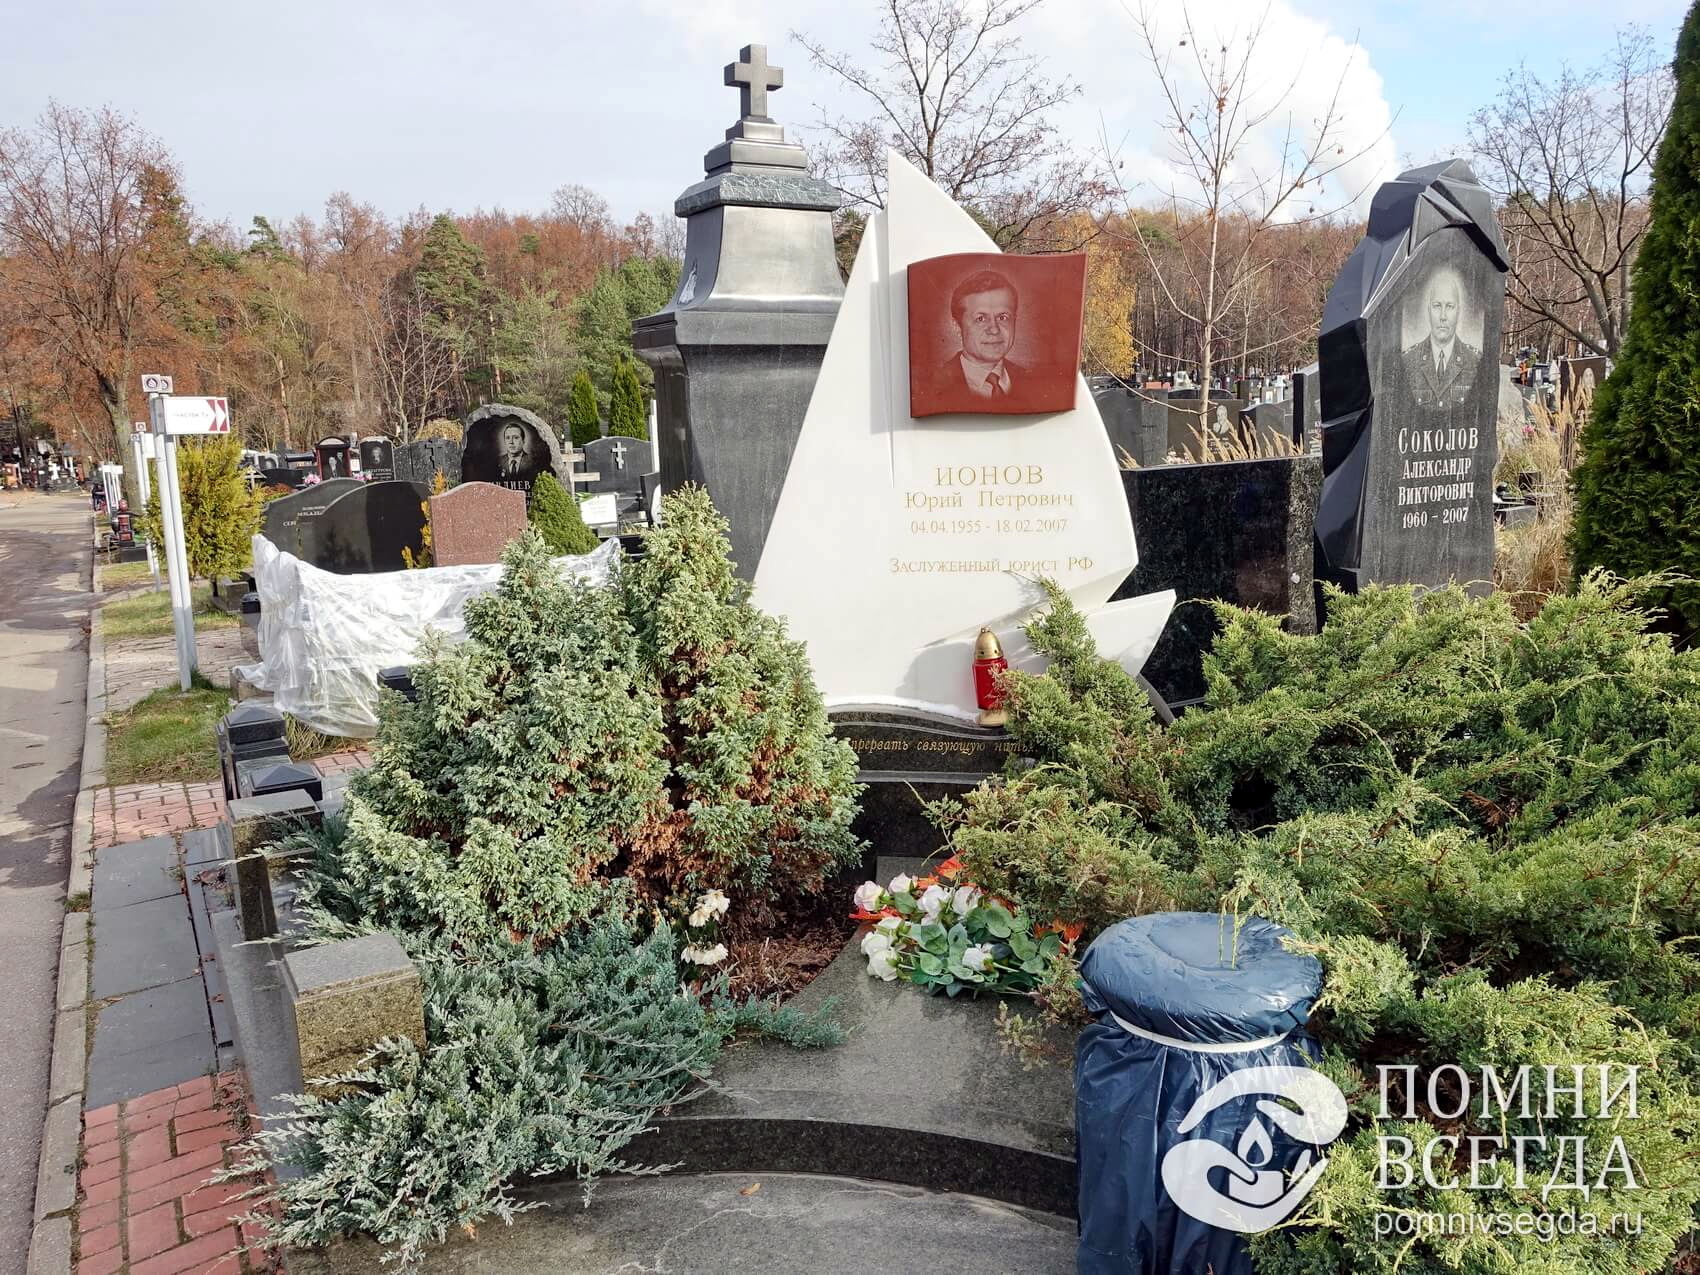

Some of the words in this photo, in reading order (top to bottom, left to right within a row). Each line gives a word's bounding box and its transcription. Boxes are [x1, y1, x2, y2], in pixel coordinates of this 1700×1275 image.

[936, 464, 1043, 486] ИОНОВ
[904, 490, 963, 512] Юрий
[978, 490, 1074, 511] Петрович
[910, 519, 982, 536] 04.04.1955
[995, 518, 1068, 535] 18.02.2007
[1403, 510, 1428, 529] 1960
[1442, 507, 1470, 524] 2007
[1067, 556, 1094, 571] РФ
[916, 738, 986, 756] связующую
